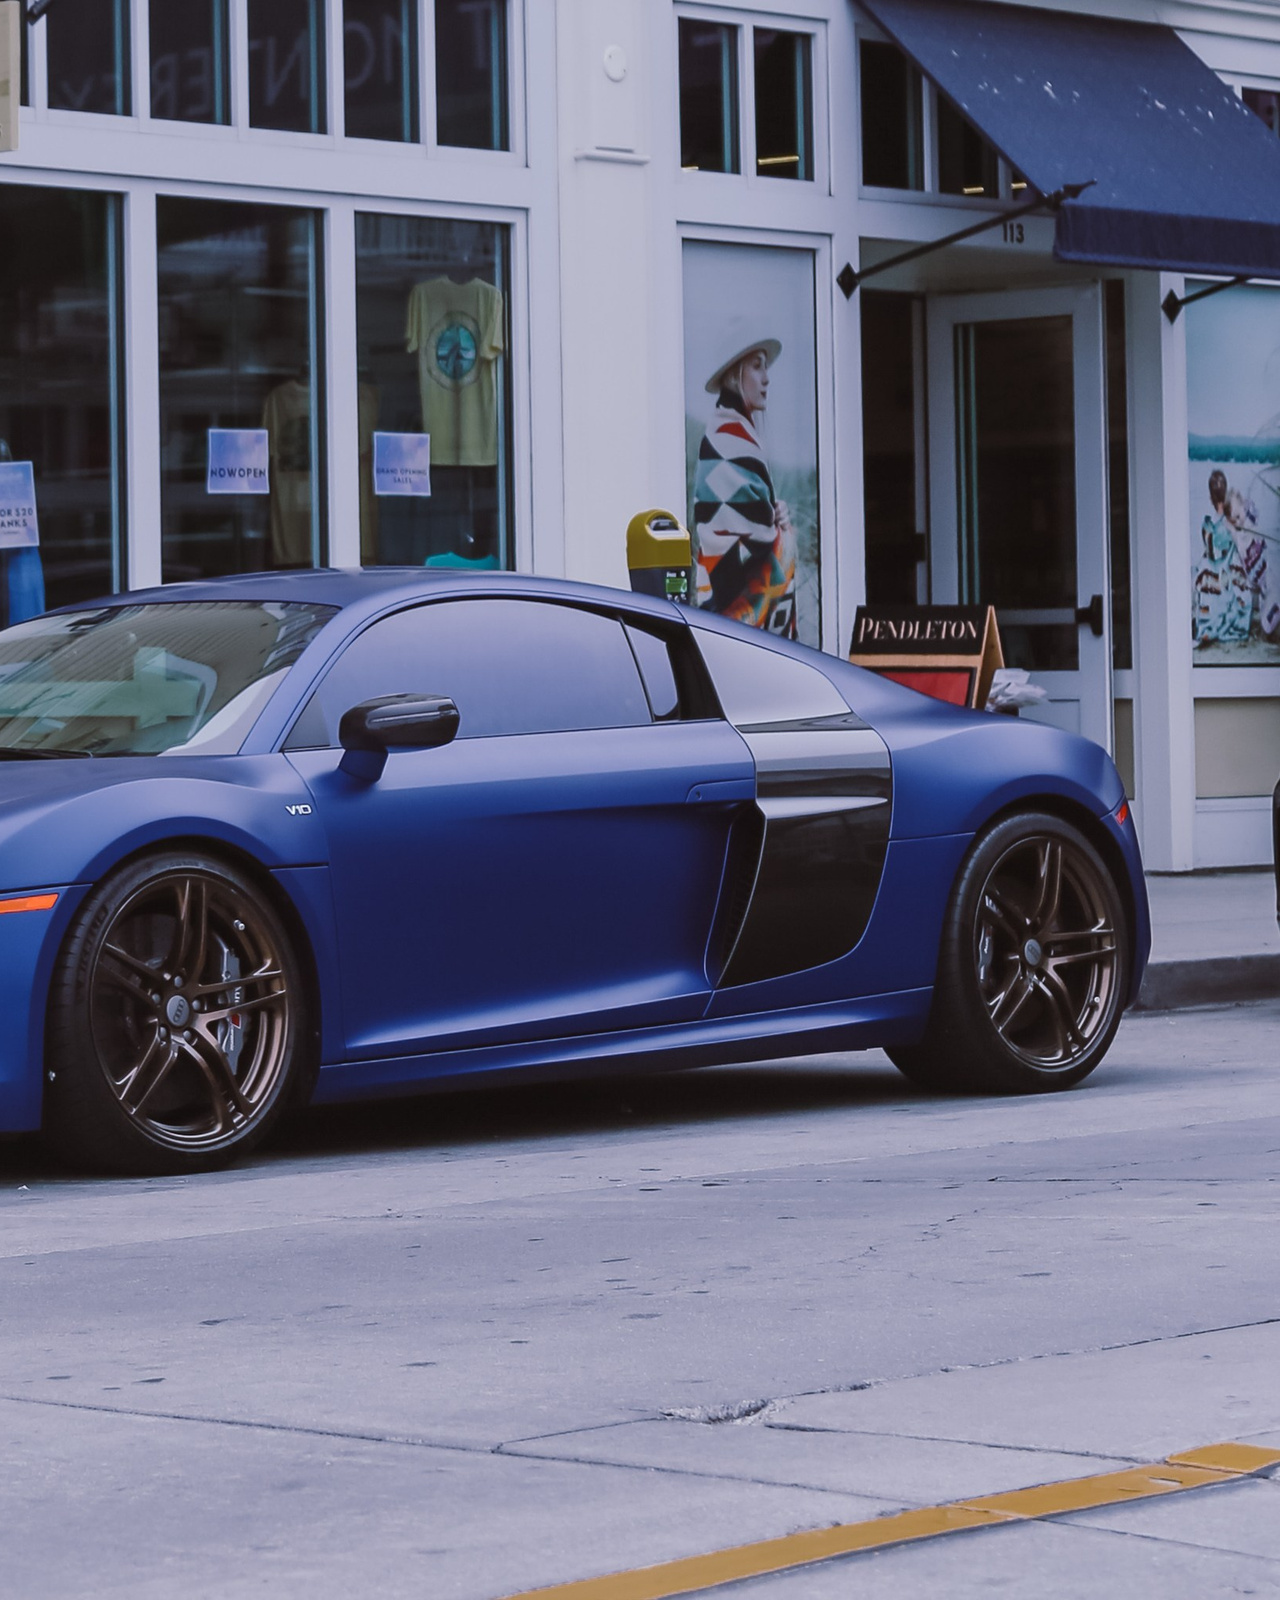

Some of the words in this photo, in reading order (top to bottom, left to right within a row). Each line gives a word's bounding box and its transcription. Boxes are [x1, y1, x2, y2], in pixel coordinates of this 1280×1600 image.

[1003, 222, 1024, 244] 113
[15, 507, 33, 517] $20
[859, 617, 978, 643] PENDLETON
[285, 804, 311, 815] V10
